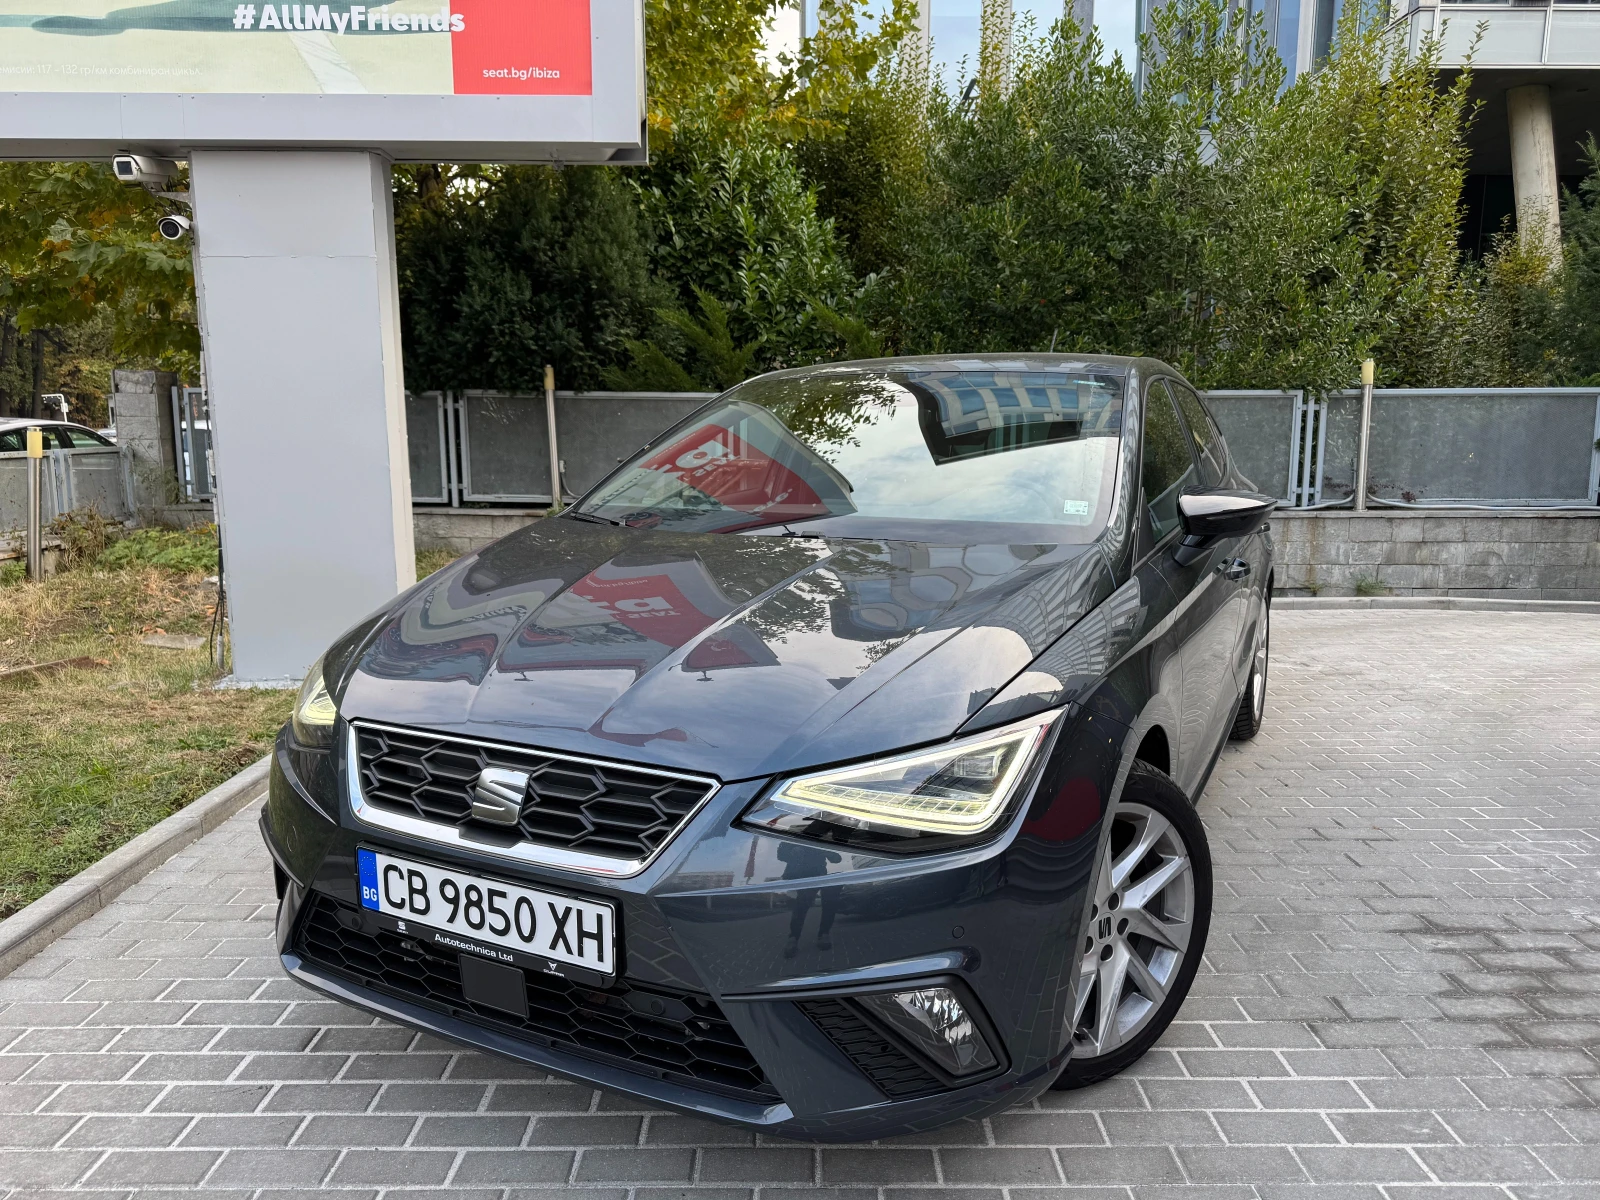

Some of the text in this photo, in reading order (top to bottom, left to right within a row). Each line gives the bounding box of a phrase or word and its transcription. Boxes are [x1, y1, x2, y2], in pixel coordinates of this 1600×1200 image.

[233, 5, 466, 36] #AllMyFriends
[37, 64, 52, 74] 117
[61, 64, 79, 75] 132
[80, 64, 108, 77] гр/км
[110, 65, 170, 77] комбиниран
[482, 67, 560, 80] seat.bg/ibiza
[363, 886, 378, 901] BG
[383, 864, 605, 963] CB 9850 XH
[434, 933, 514, 962] Autotechnica Ltd
